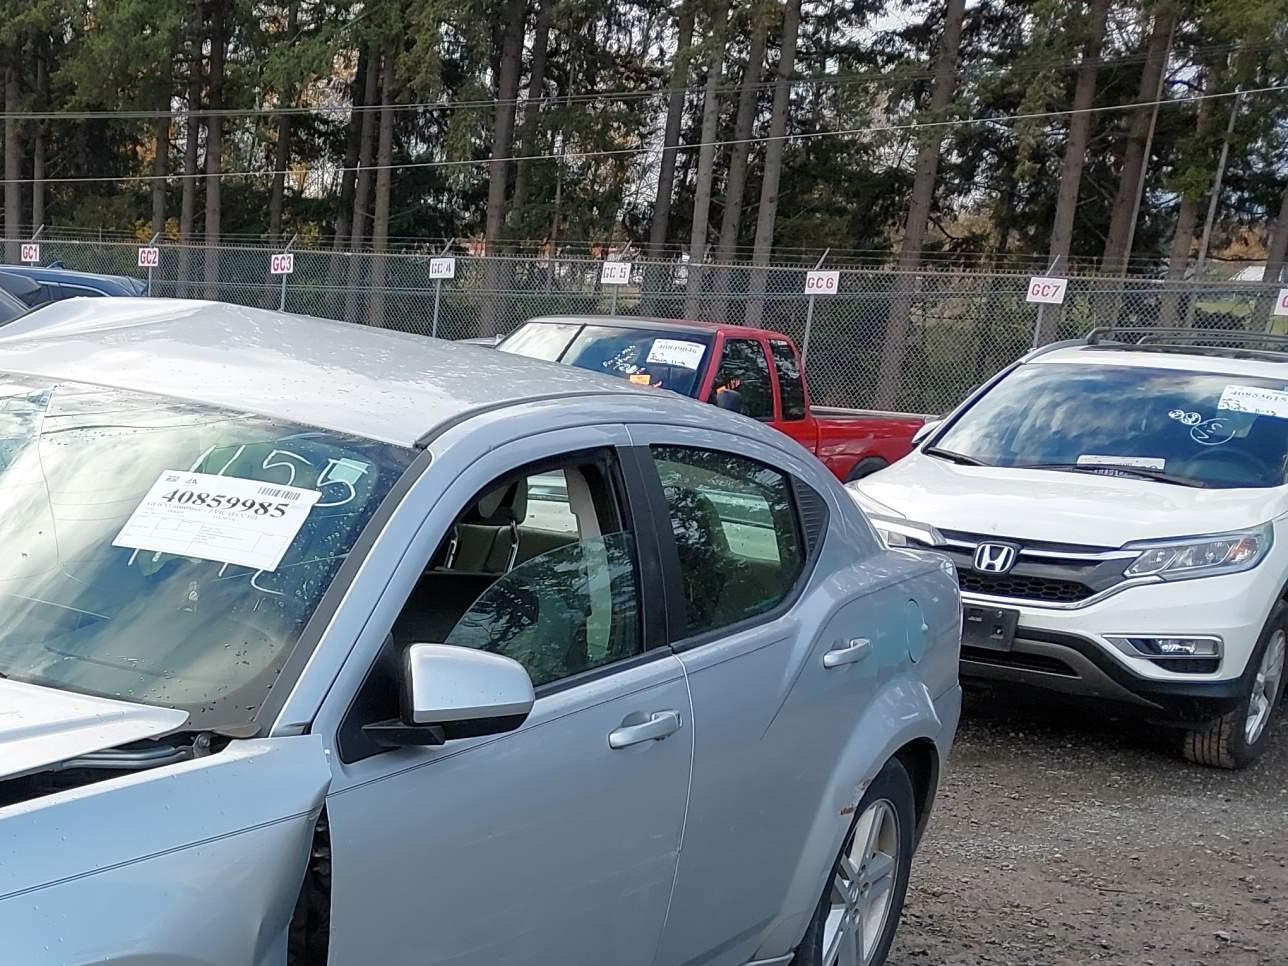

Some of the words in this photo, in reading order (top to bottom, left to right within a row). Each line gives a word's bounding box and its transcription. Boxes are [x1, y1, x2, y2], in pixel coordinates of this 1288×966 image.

[23, 246, 38, 260] GC1
[140, 250, 158, 265] GC2
[272, 255, 292, 271] GC3
[1031, 284, 1061, 299] GC7
[161, 488, 291, 519] 40859985
